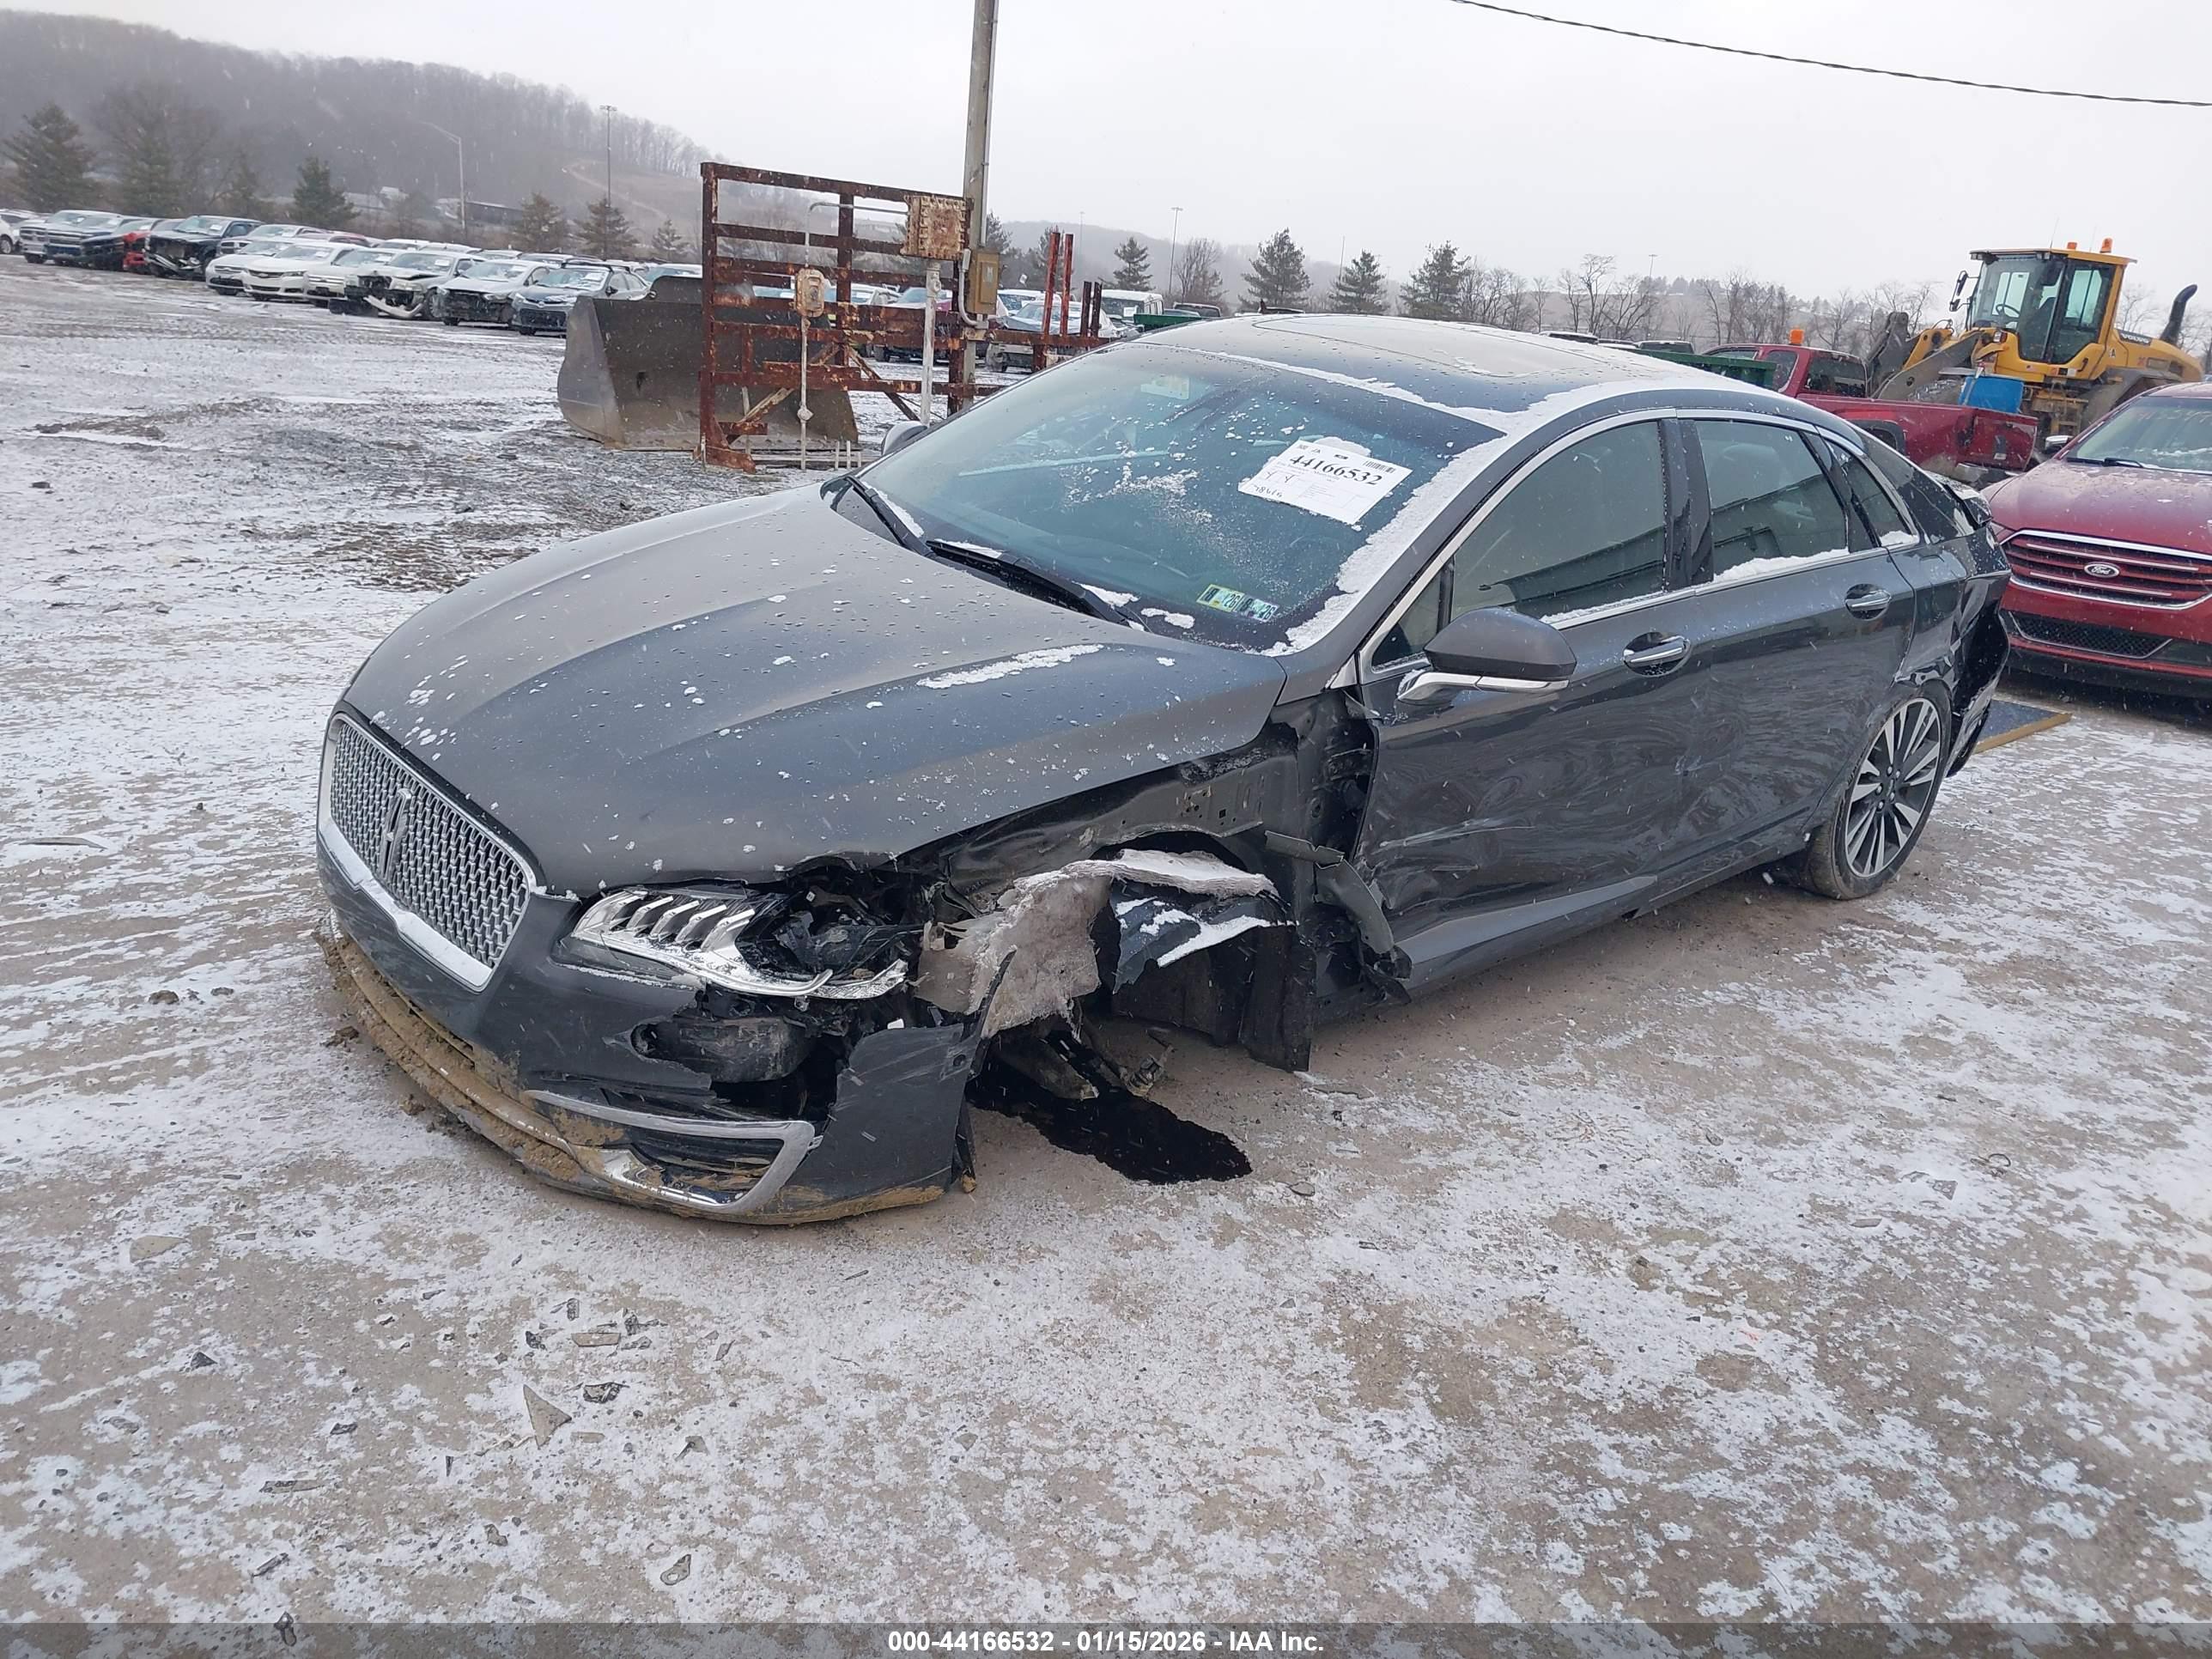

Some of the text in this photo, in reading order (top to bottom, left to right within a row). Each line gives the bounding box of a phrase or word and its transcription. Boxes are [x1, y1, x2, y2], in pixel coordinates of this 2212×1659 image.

[2120, 332, 2150, 344] VOLVO
[1289, 454, 1383, 486] 44166532
[2090, 564, 2112, 575] Ford
